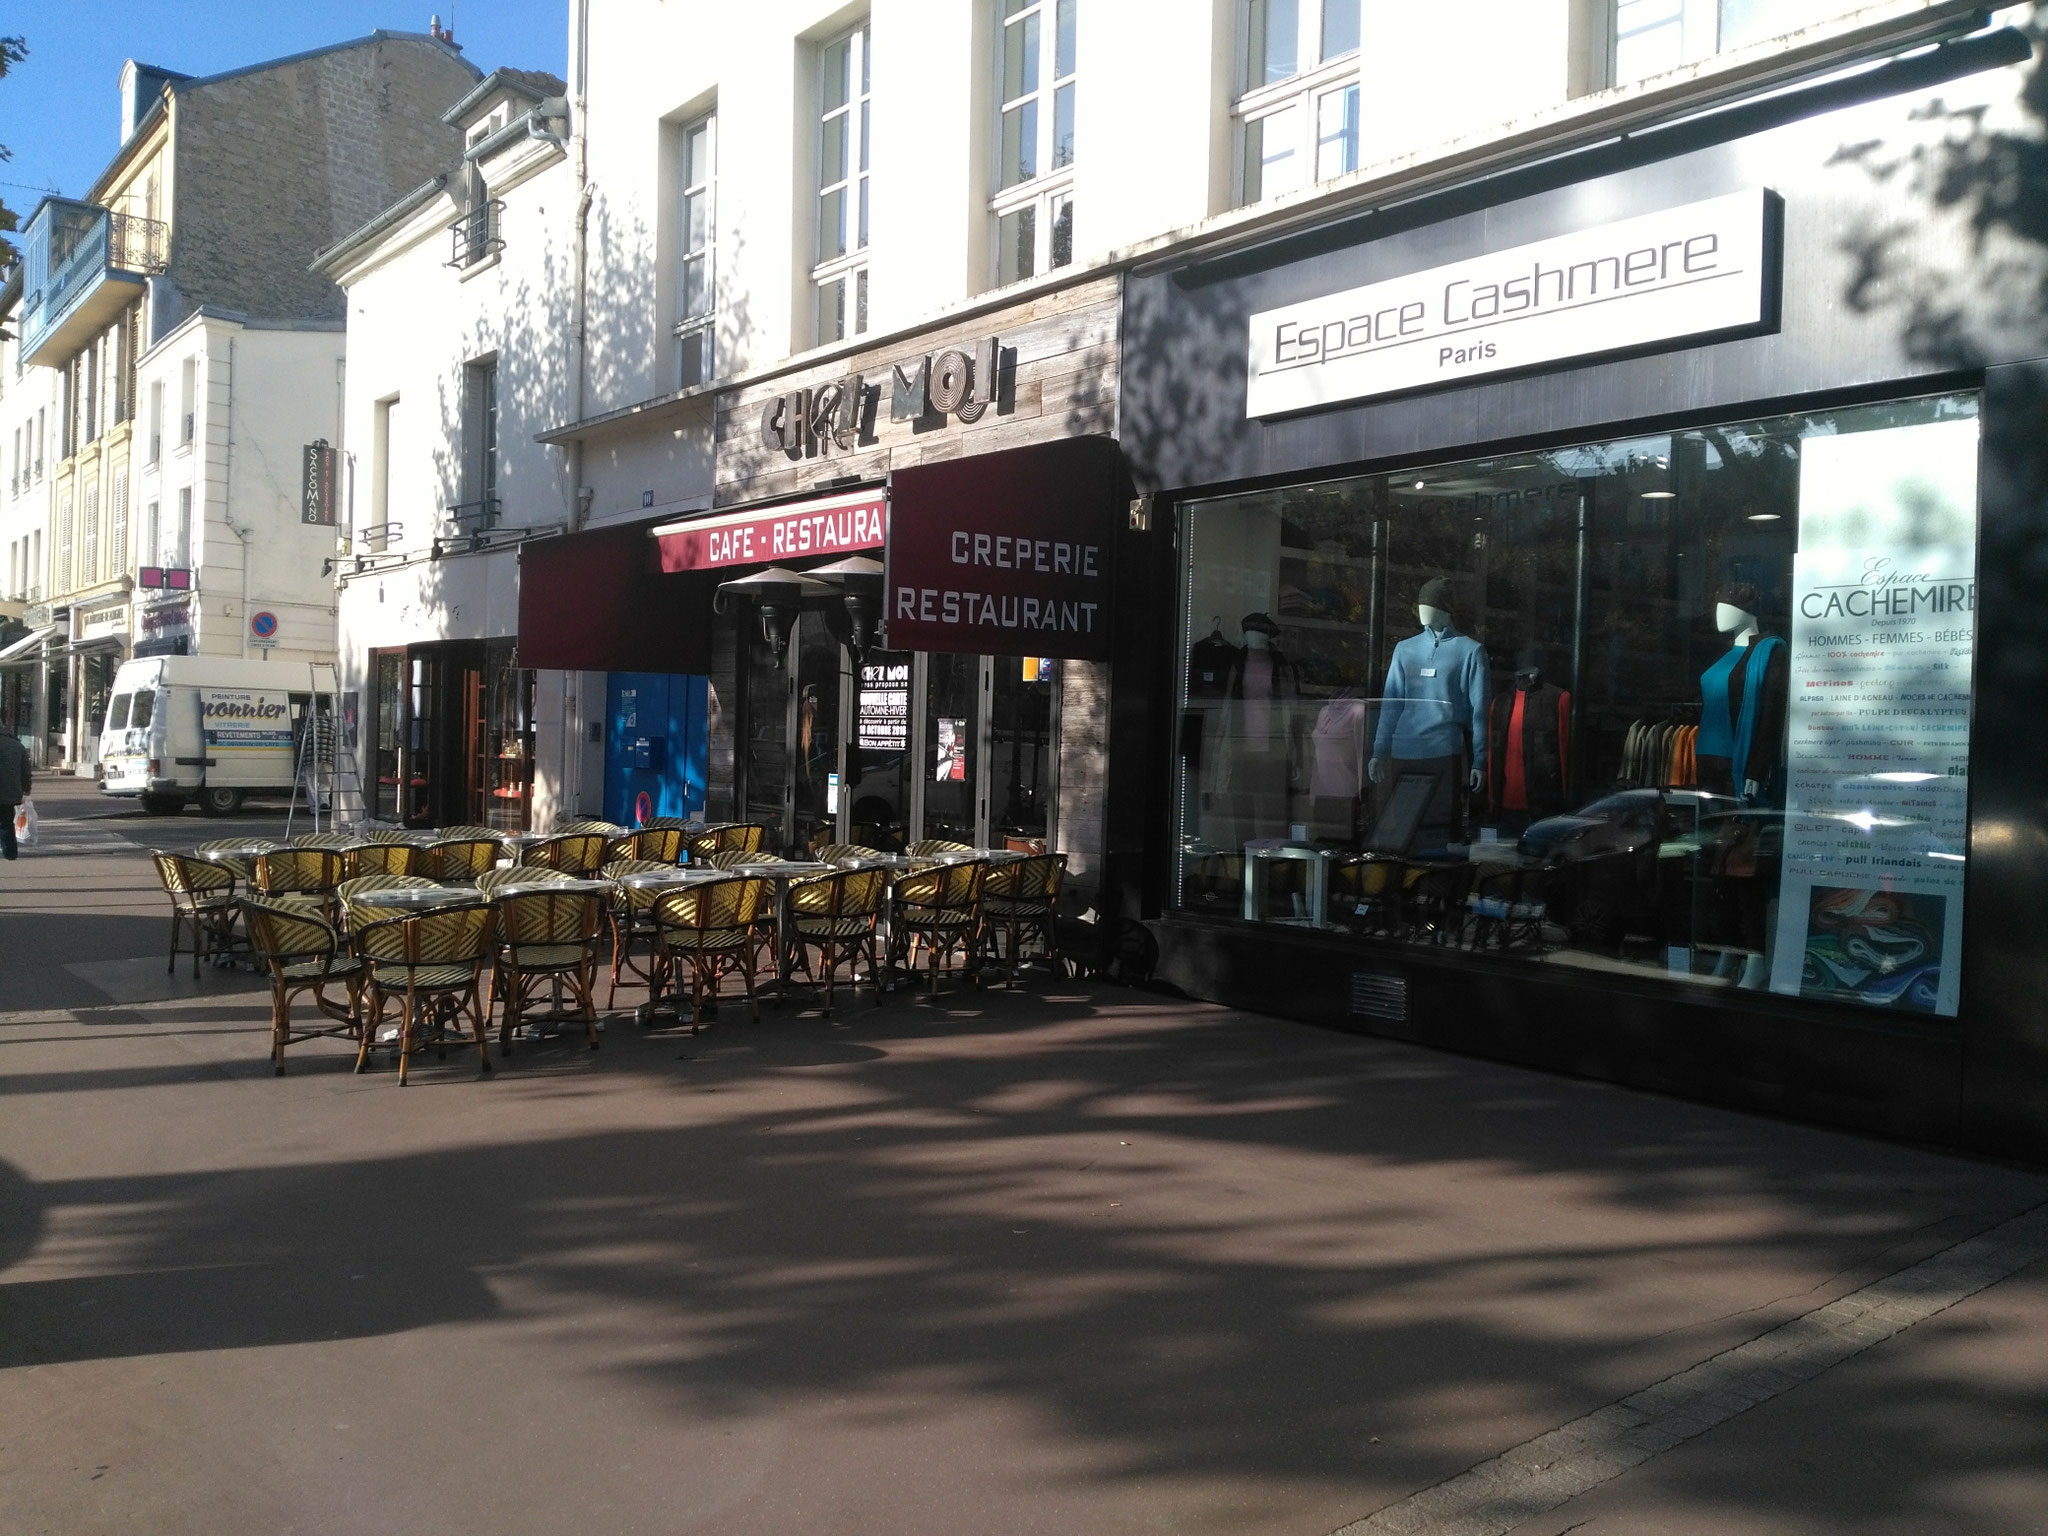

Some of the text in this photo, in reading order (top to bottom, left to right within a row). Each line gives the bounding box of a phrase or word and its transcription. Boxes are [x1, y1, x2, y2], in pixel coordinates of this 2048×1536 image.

[1275, 232, 1718, 365] Espace Cashmere
[1439, 340, 1498, 367] Paris
[891, 336, 999, 424] MOI
[710, 508, 882, 562] CAFE RESTAURA
[951, 530, 1099, 577] CREPERIE
[1861, 557, 1930, 595] Espace
[897, 586, 1098, 633] RESTAURANT
[1871, 617, 1916, 628] Depuis 1970
[1808, 628, 1973, 647] HOMMES FEMMES BÉBÉS
[1845, 855, 1867, 866] pull
[1871, 856, 1921, 868] Irlandais
